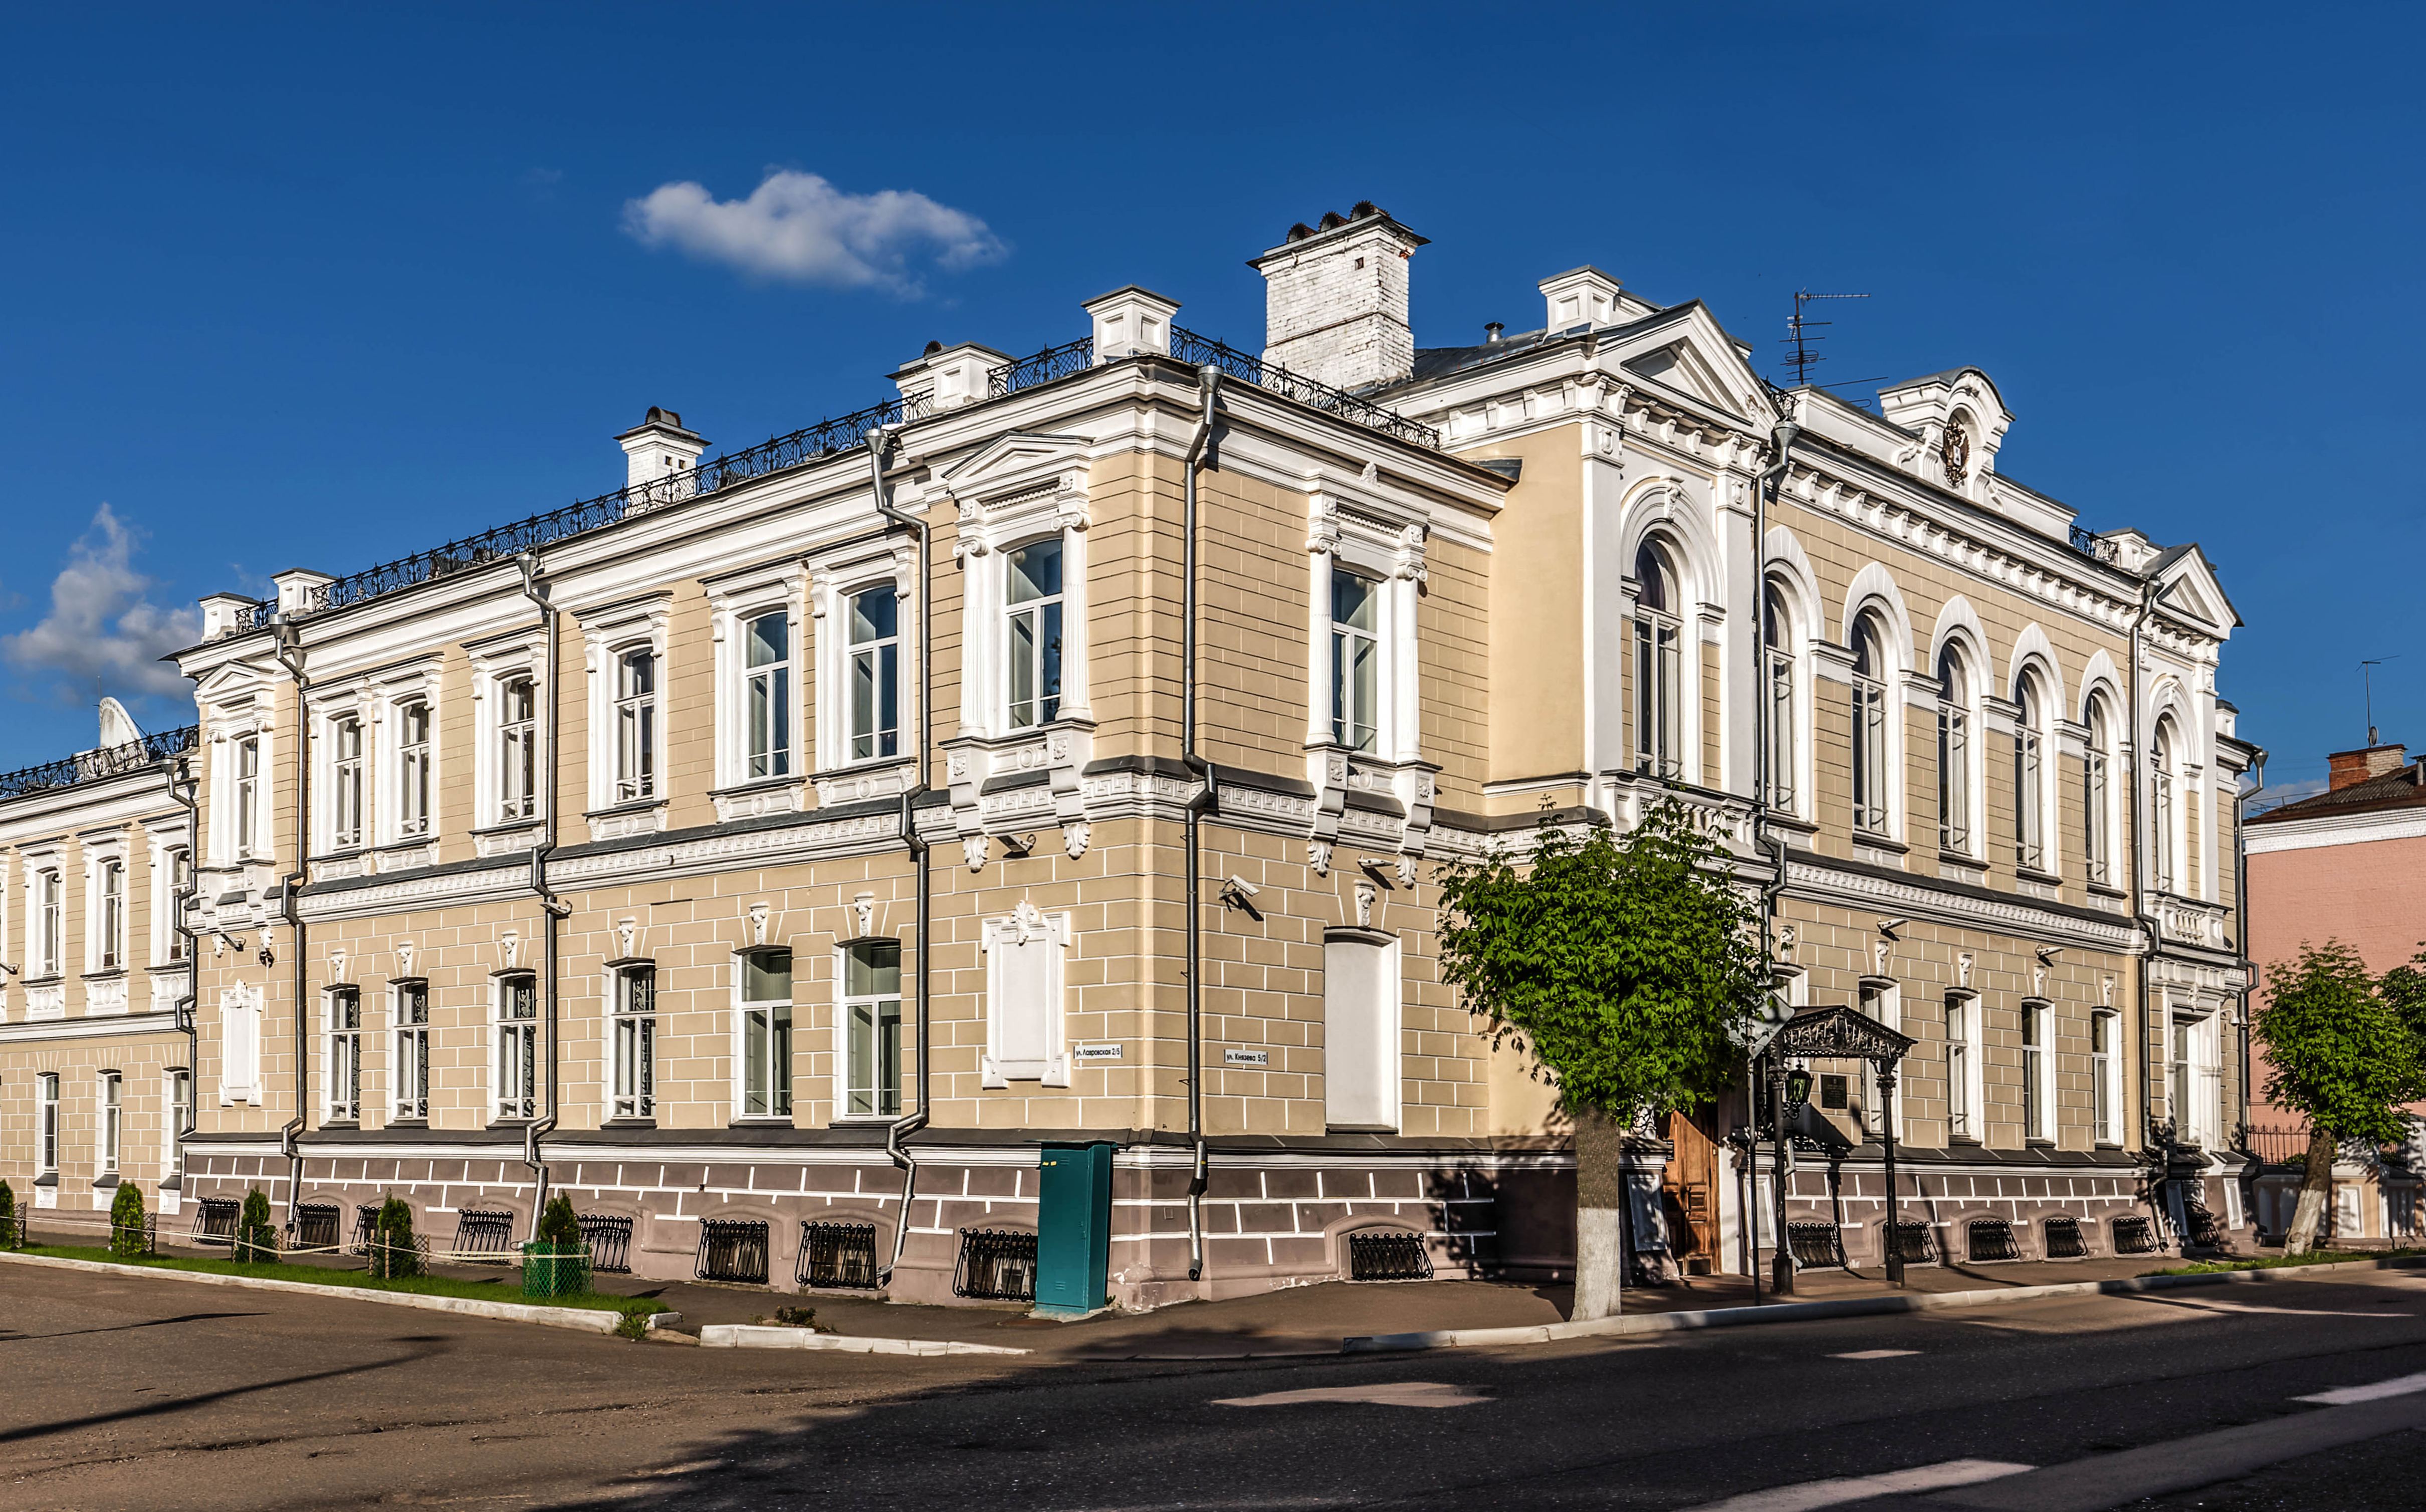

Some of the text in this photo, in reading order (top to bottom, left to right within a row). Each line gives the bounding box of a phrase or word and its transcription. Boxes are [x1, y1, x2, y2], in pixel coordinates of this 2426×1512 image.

[1083, 1049, 1111, 1057] Лавровская
[1235, 1053, 1256, 1061] Князева
[1258, 1054, 1266, 1062] 5/2
